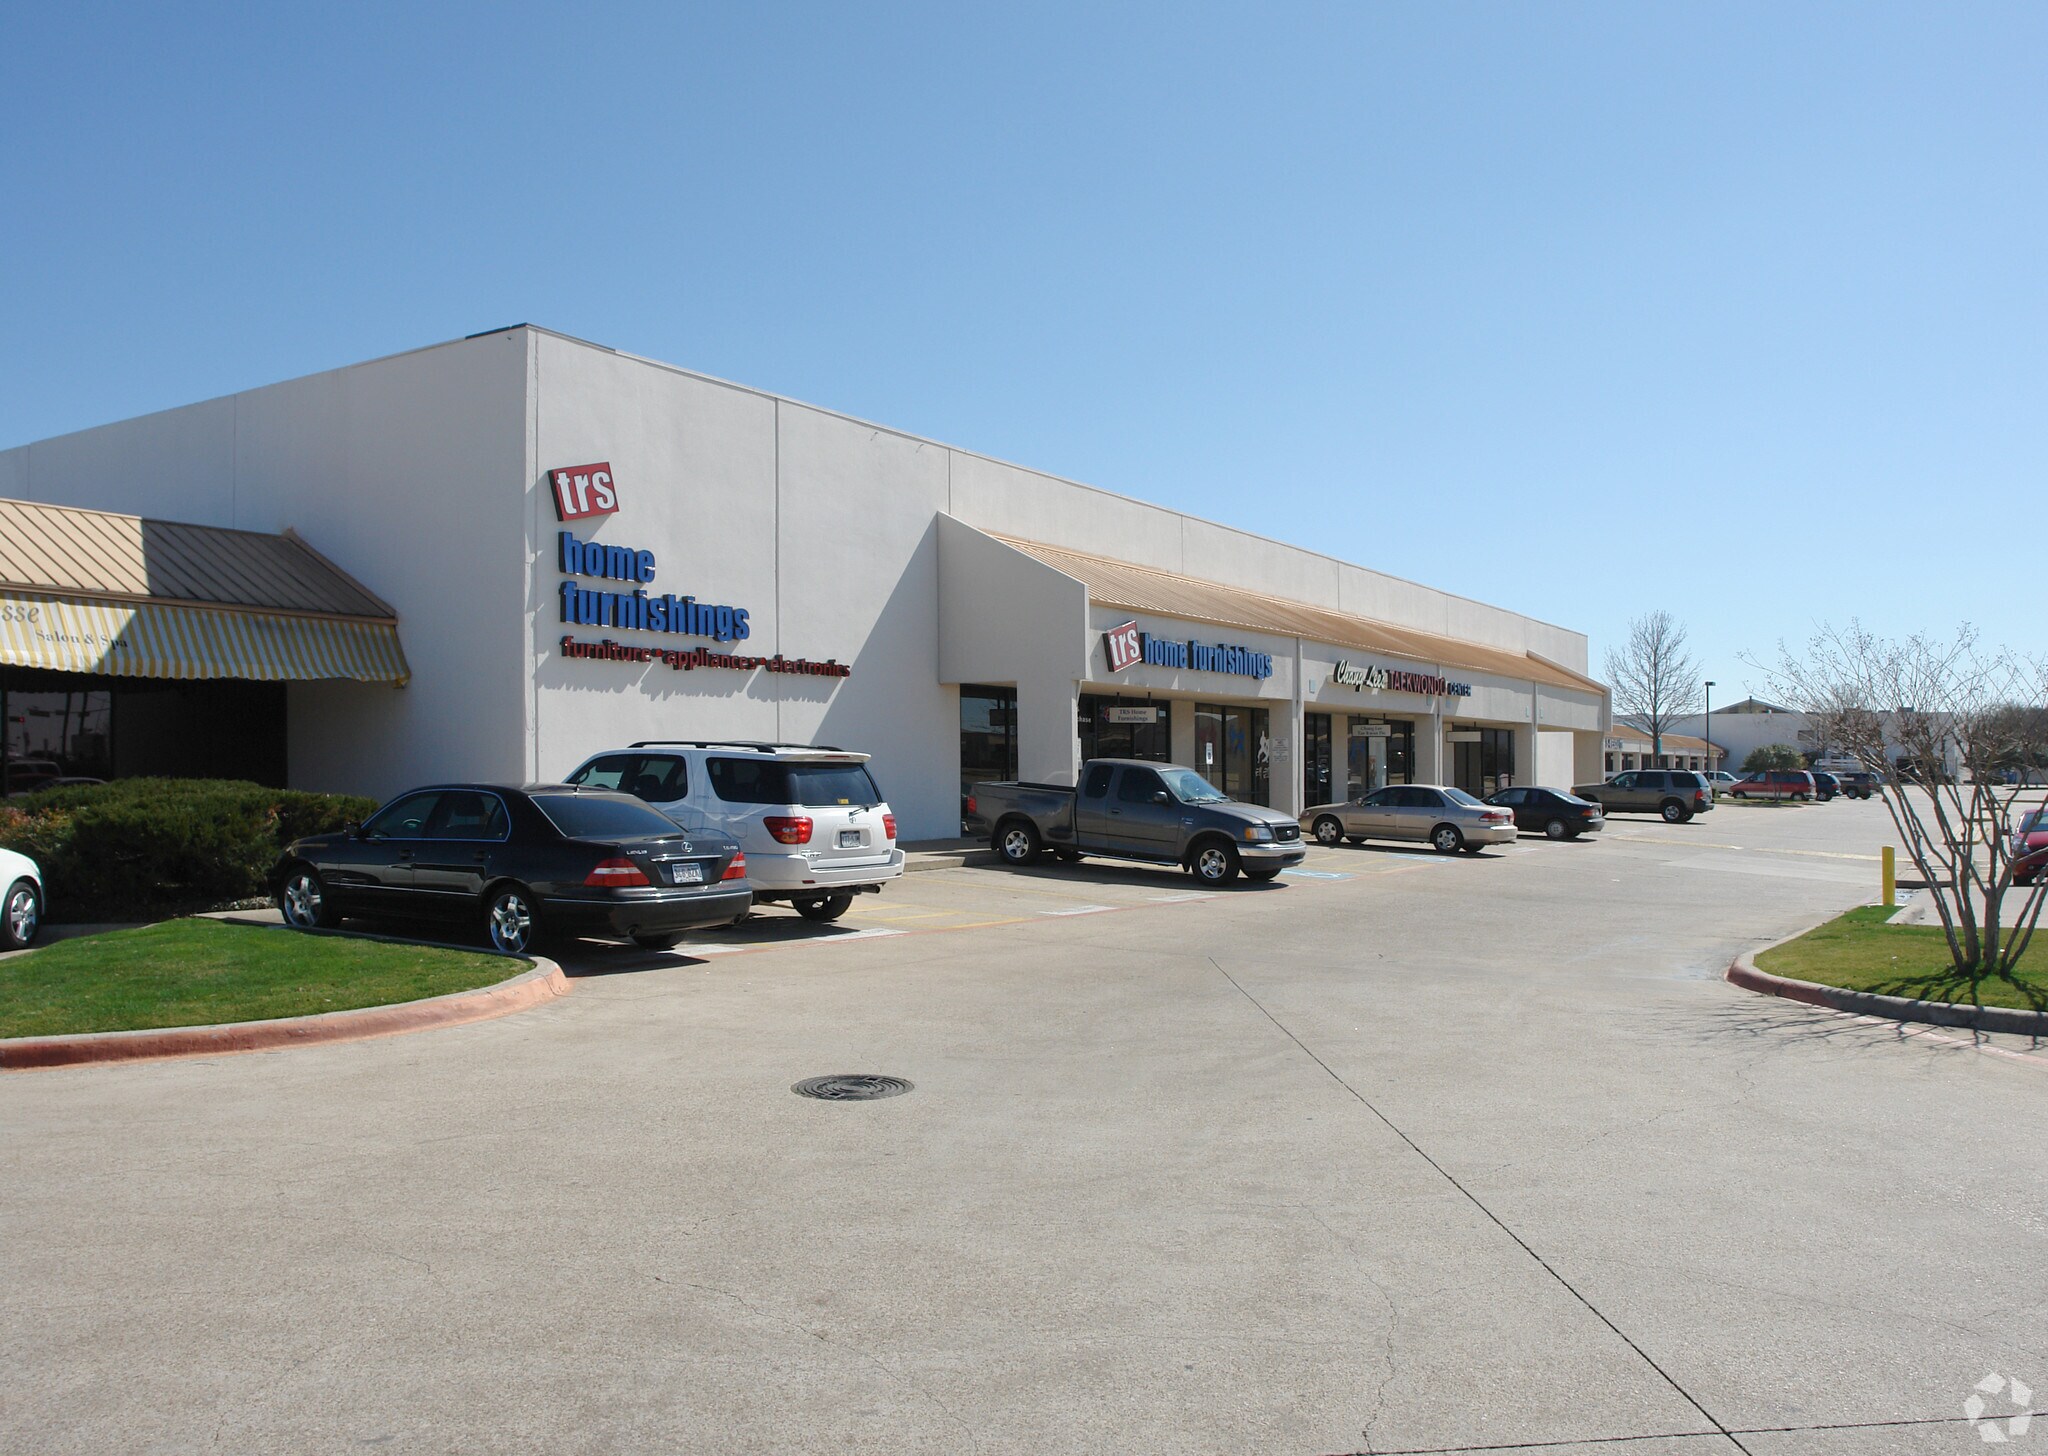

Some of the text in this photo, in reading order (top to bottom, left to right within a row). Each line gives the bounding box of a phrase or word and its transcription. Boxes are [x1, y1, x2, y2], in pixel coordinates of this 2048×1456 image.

[557, 470, 616, 515] trs
[558, 531, 656, 583] home
[559, 581, 750, 642] furnishings
[35, 629, 128, 650] Salon & Spa
[560, 636, 851, 677] furniture appliances electronics
[1109, 629, 1141, 667] trs
[1140, 632, 1273, 680] home furnishings
[1334, 659, 1364, 692] Chang
[1387, 669, 1447, 697] TAEKWONDO
[1449, 682, 1472, 697] CENTER
